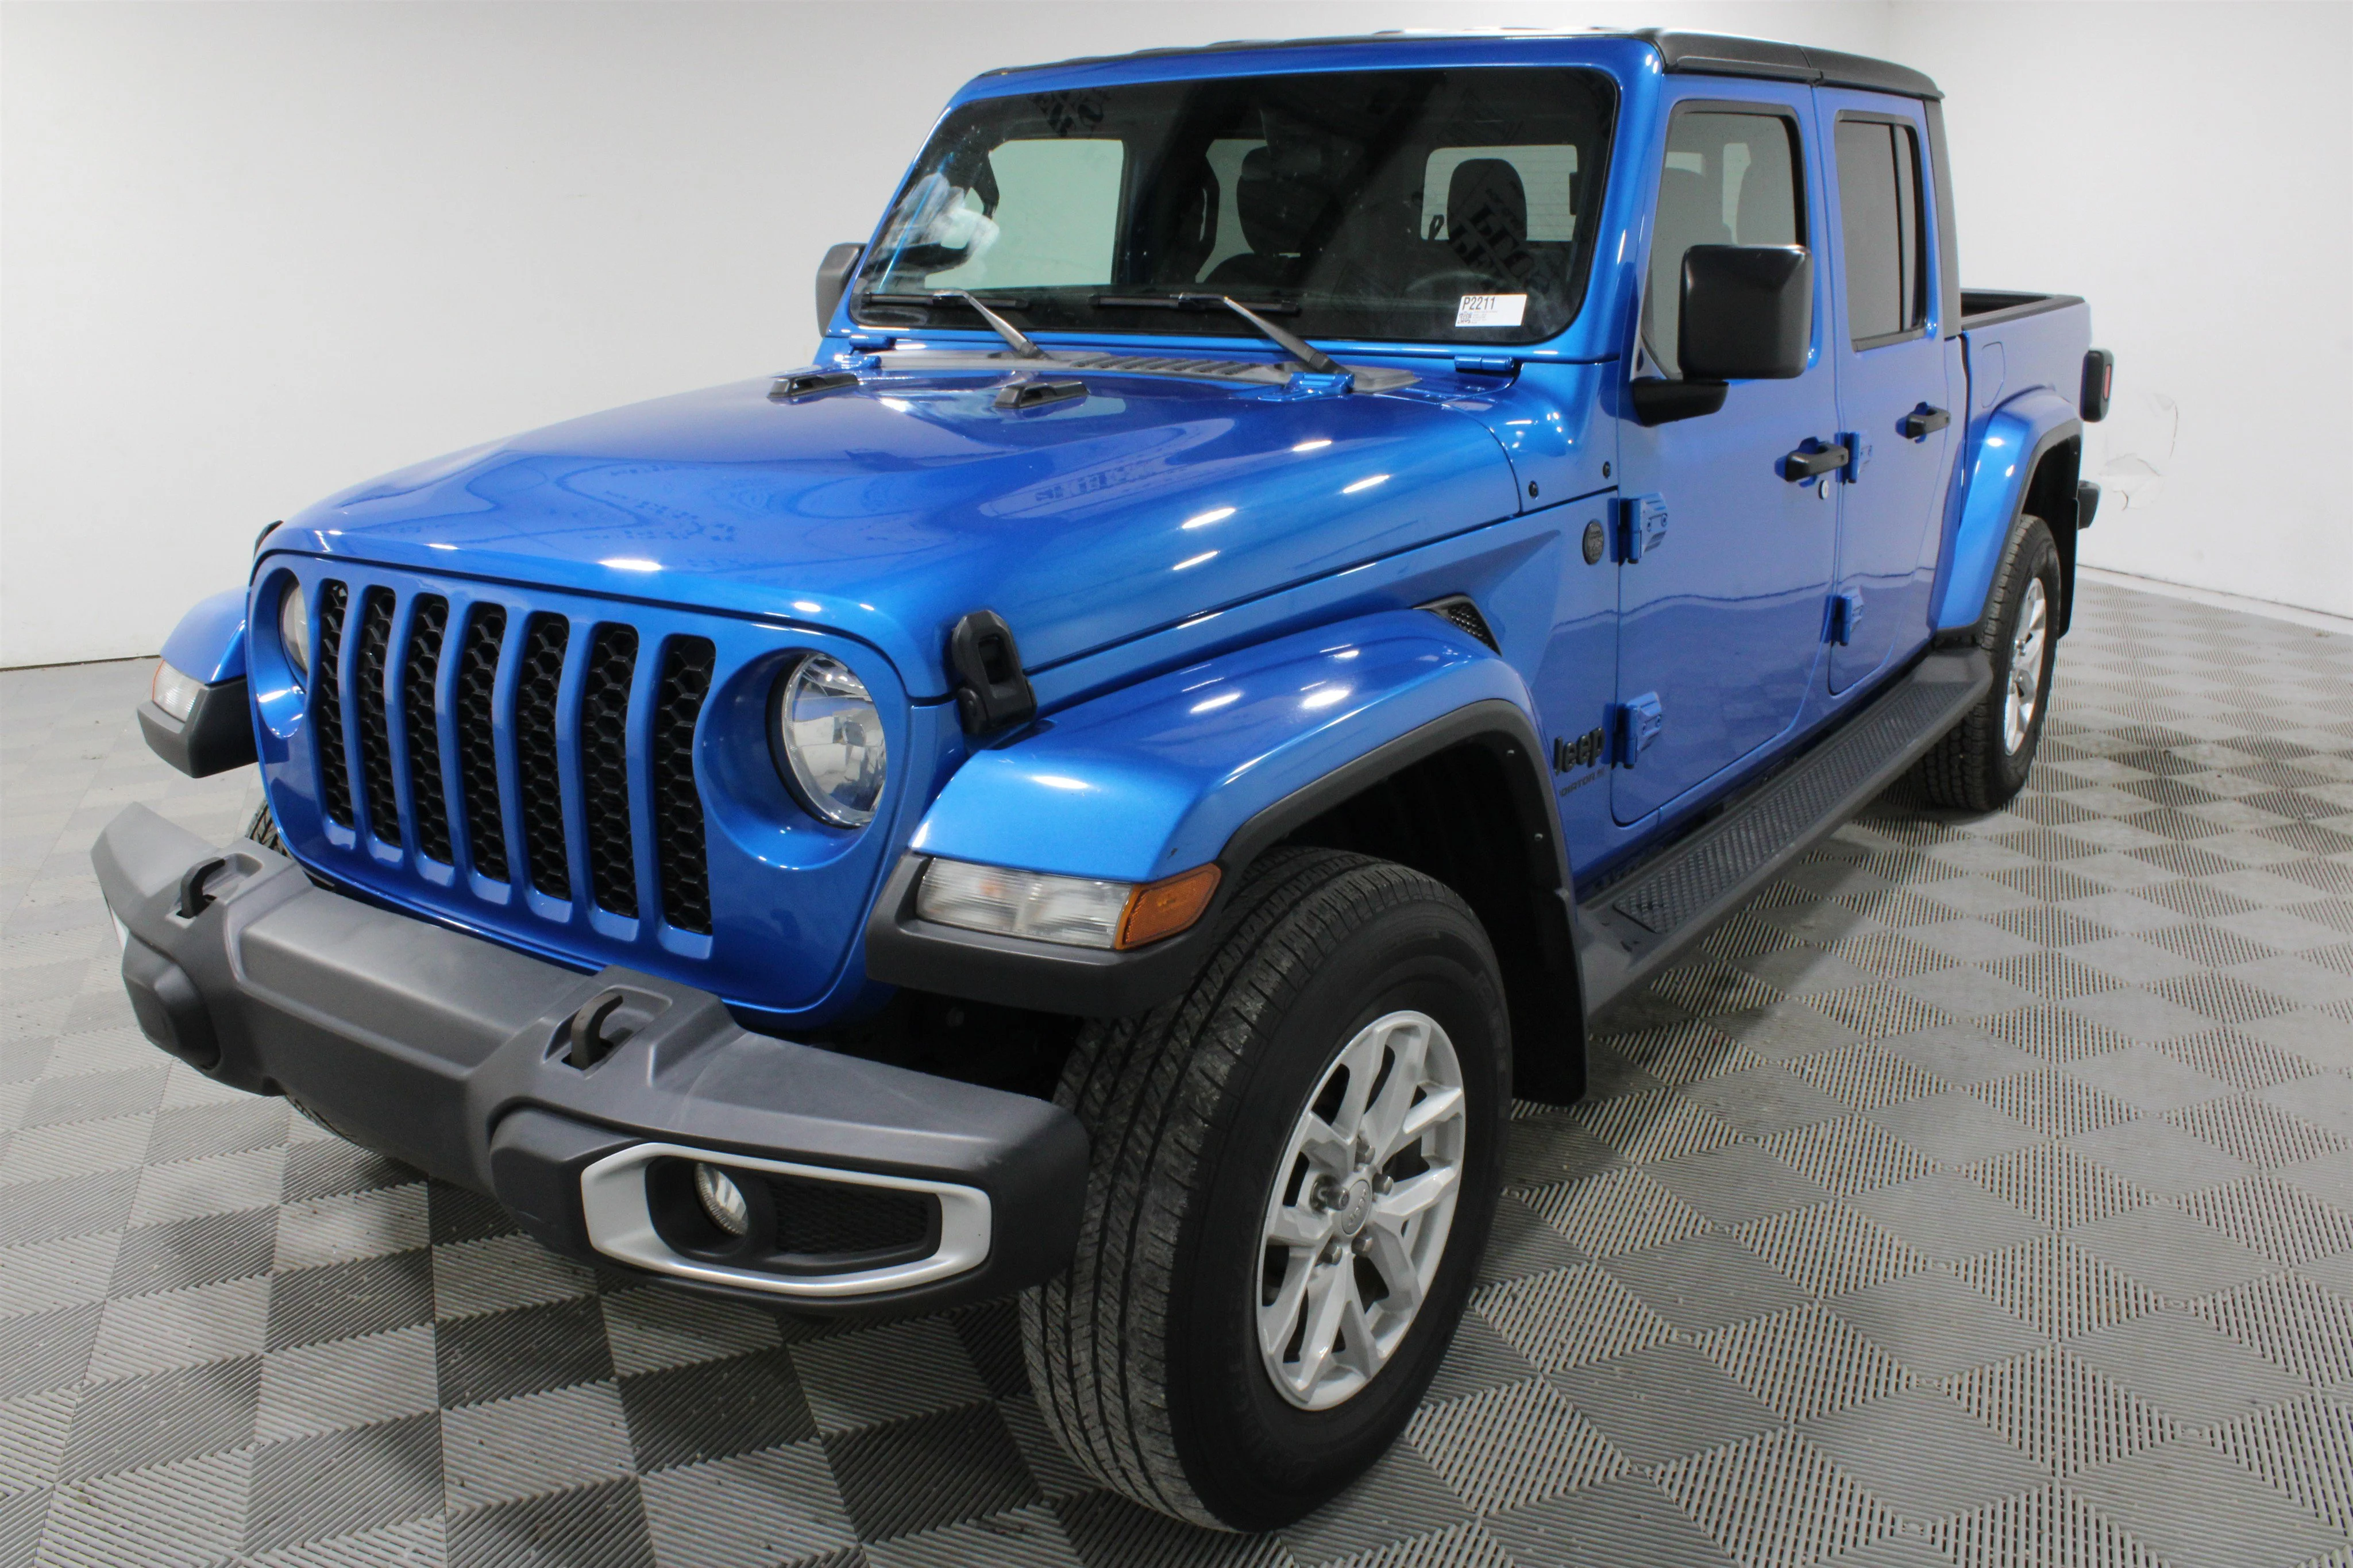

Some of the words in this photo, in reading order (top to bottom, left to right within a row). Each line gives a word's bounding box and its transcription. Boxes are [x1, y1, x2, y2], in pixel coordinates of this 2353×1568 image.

[1462, 296, 1495, 311] P2211
[1553, 727, 1605, 777] Jeep
[1348, 1188, 1367, 1226] Jeep
